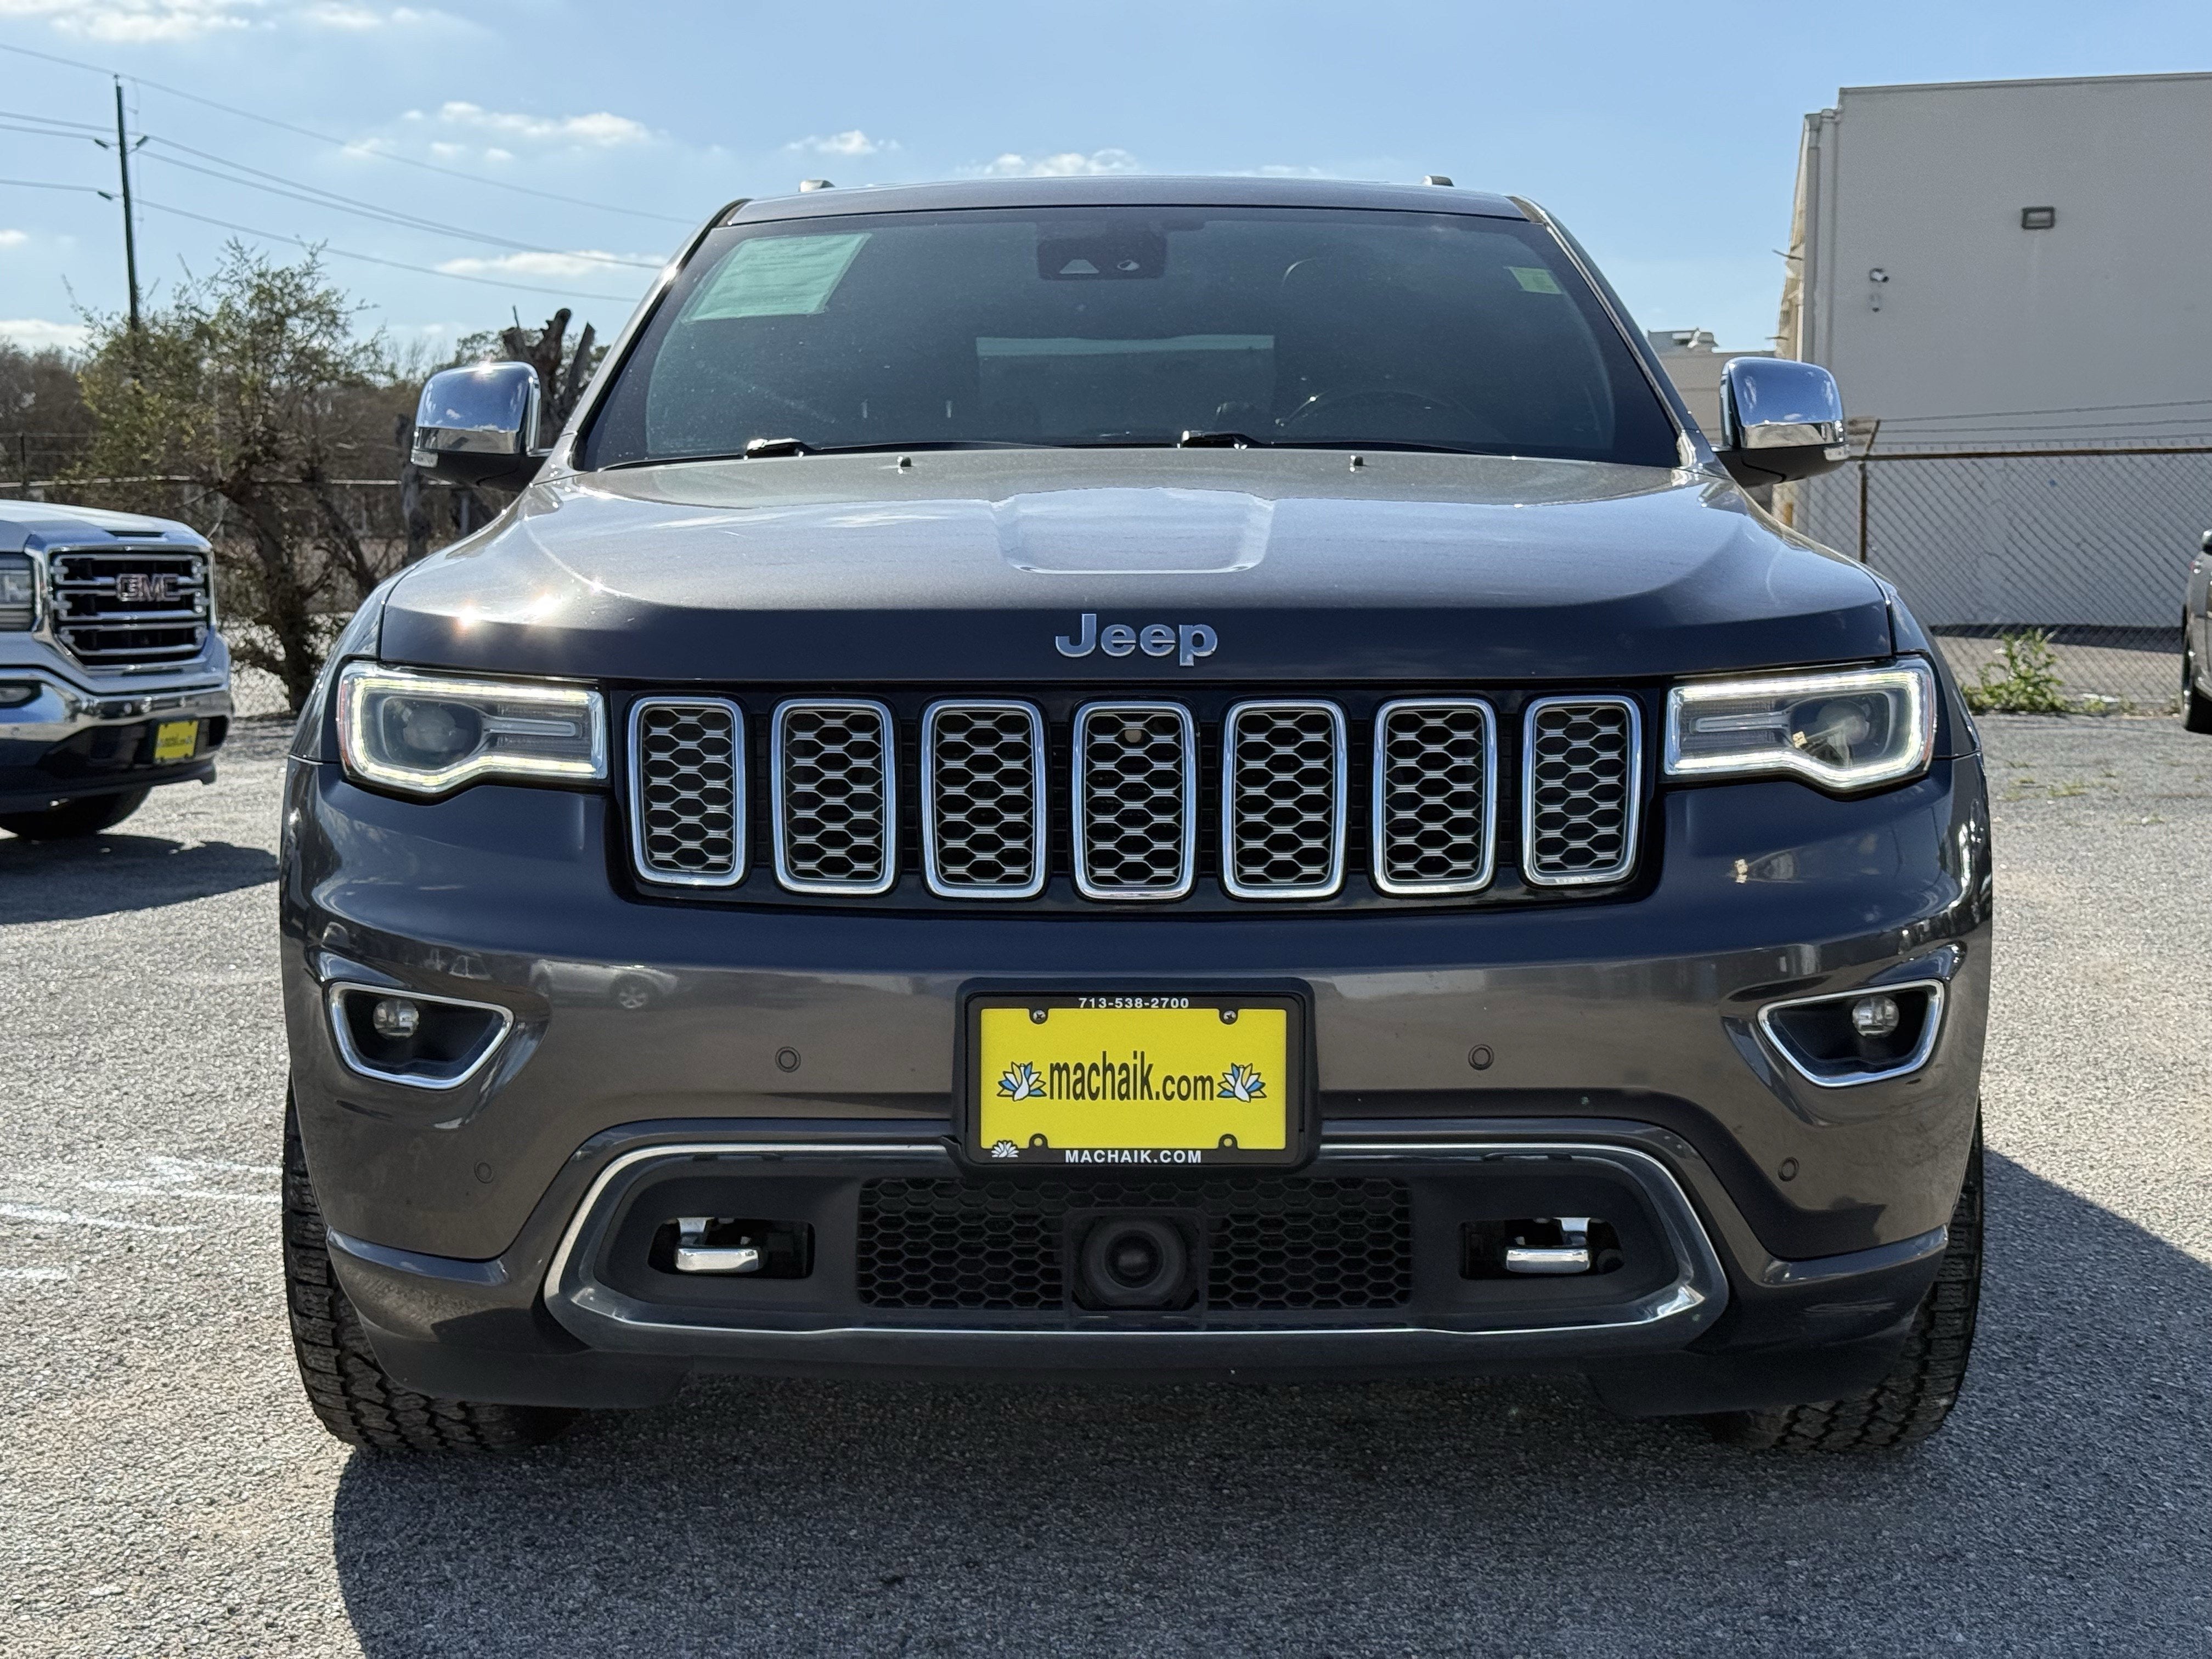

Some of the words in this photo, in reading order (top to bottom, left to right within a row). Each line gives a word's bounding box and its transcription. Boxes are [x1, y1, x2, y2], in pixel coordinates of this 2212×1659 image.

[116, 573, 180, 601] GMC
[1056, 613, 1218, 666] Jeep
[1079, 997, 1189, 1009] 713-538-2700
[1049, 1050, 1215, 1101] machaik.com
[1065, 1150, 1202, 1164] MACHAIK.COM
